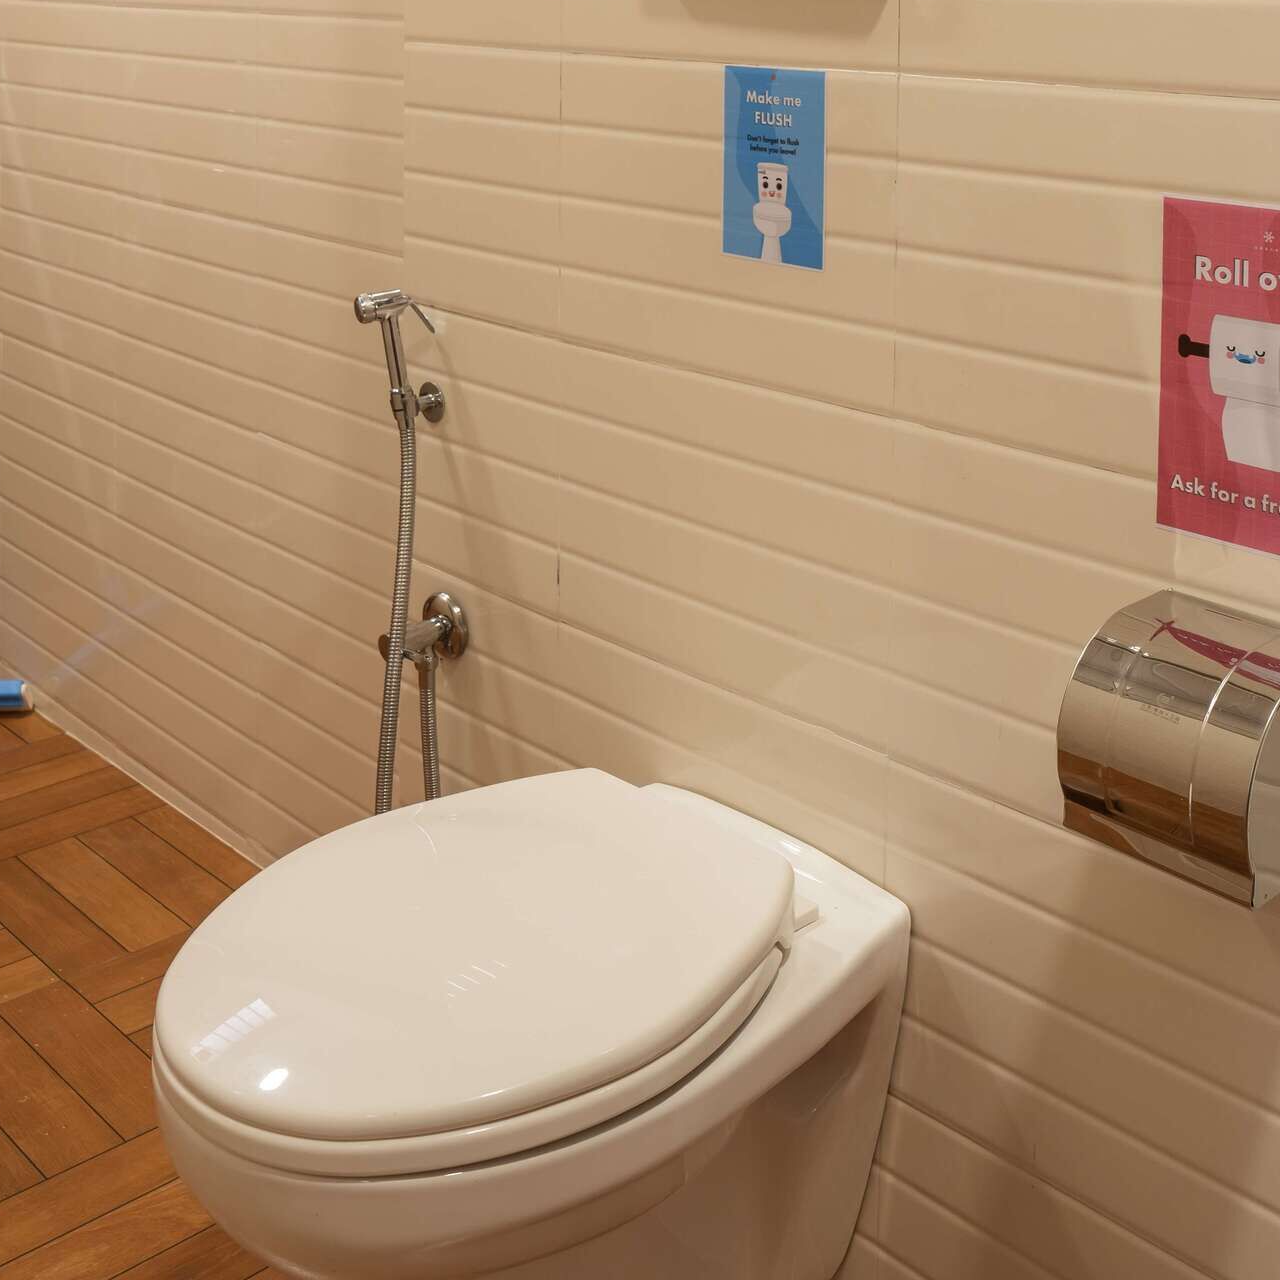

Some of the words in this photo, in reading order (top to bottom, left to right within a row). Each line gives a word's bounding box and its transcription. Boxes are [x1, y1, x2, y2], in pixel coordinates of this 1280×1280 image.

[746, 90, 781, 105] Make
[783, 96, 802, 107] me
[754, 111, 792, 127] FLUSH
[1195, 255, 1249, 288] Roll
[1170, 474, 1205, 497] Ask
[1210, 482, 1239, 504] for
[1243, 495, 1256, 509] a
